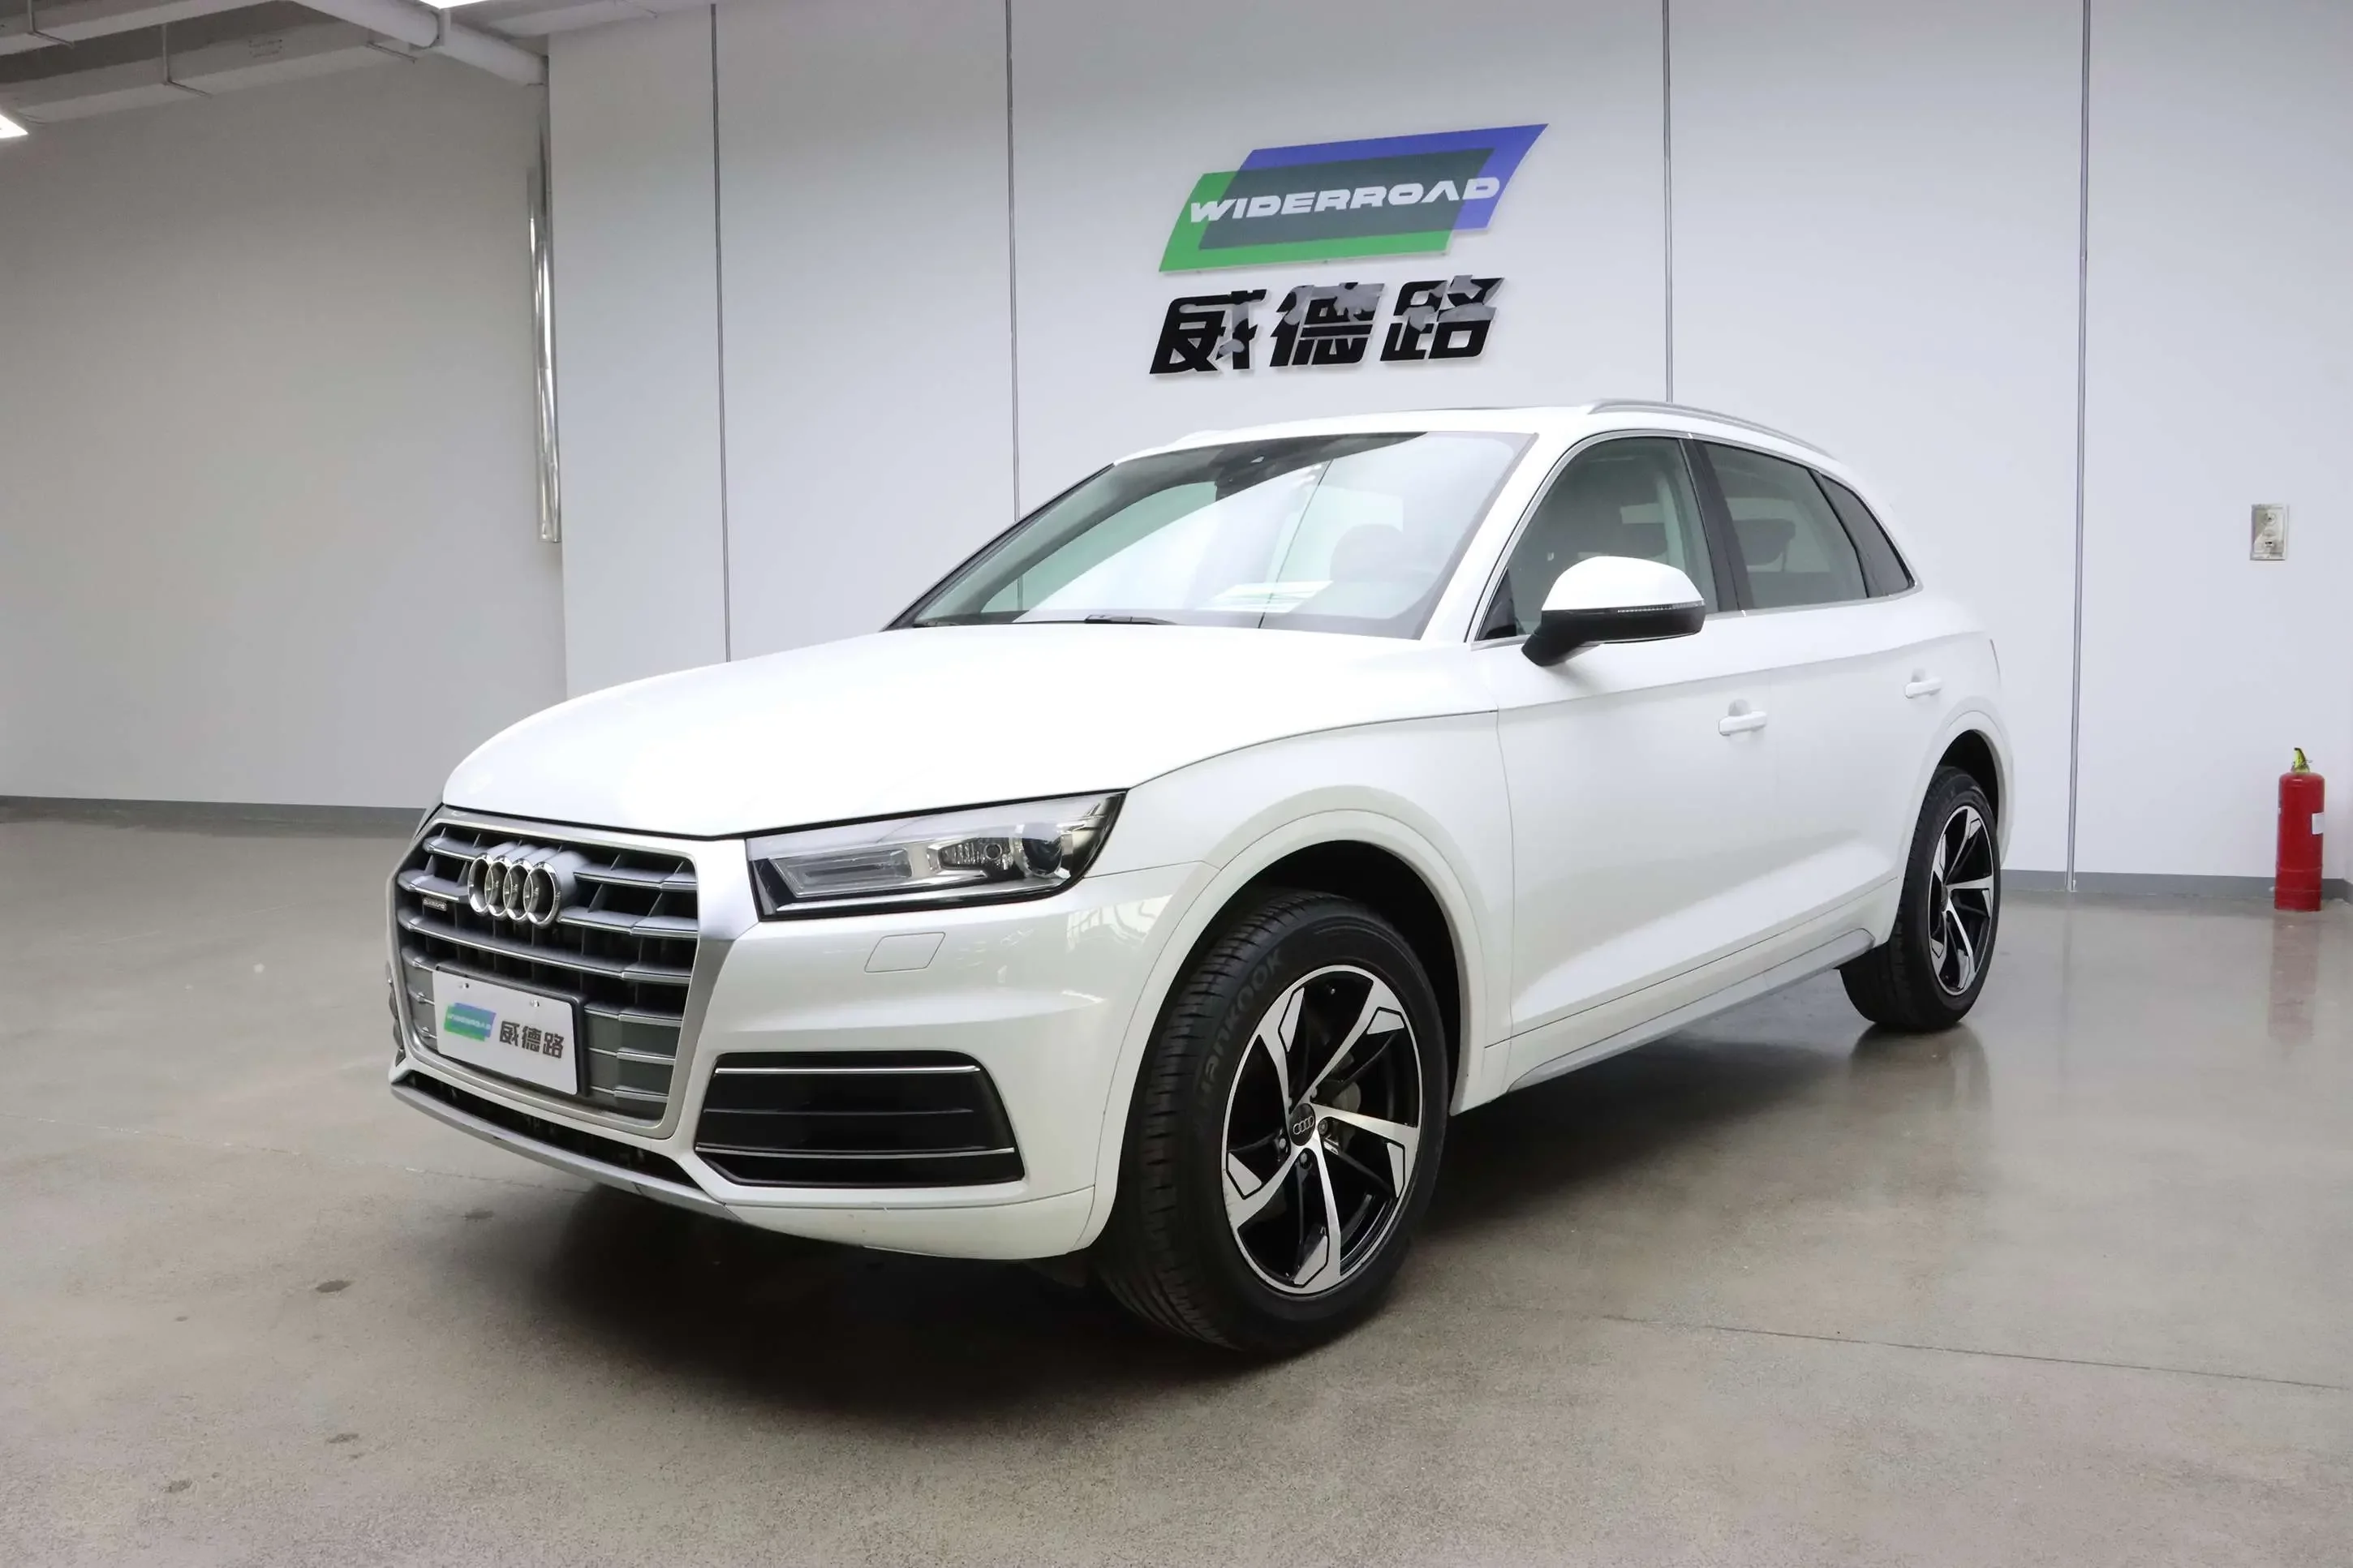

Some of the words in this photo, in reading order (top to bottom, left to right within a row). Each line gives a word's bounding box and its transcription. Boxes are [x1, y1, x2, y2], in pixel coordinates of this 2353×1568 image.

[1190, 177, 1500, 222] WIDERROAD
[1149, 275, 1505, 375] 威德路
[499, 1020, 565, 1059] 威德路
